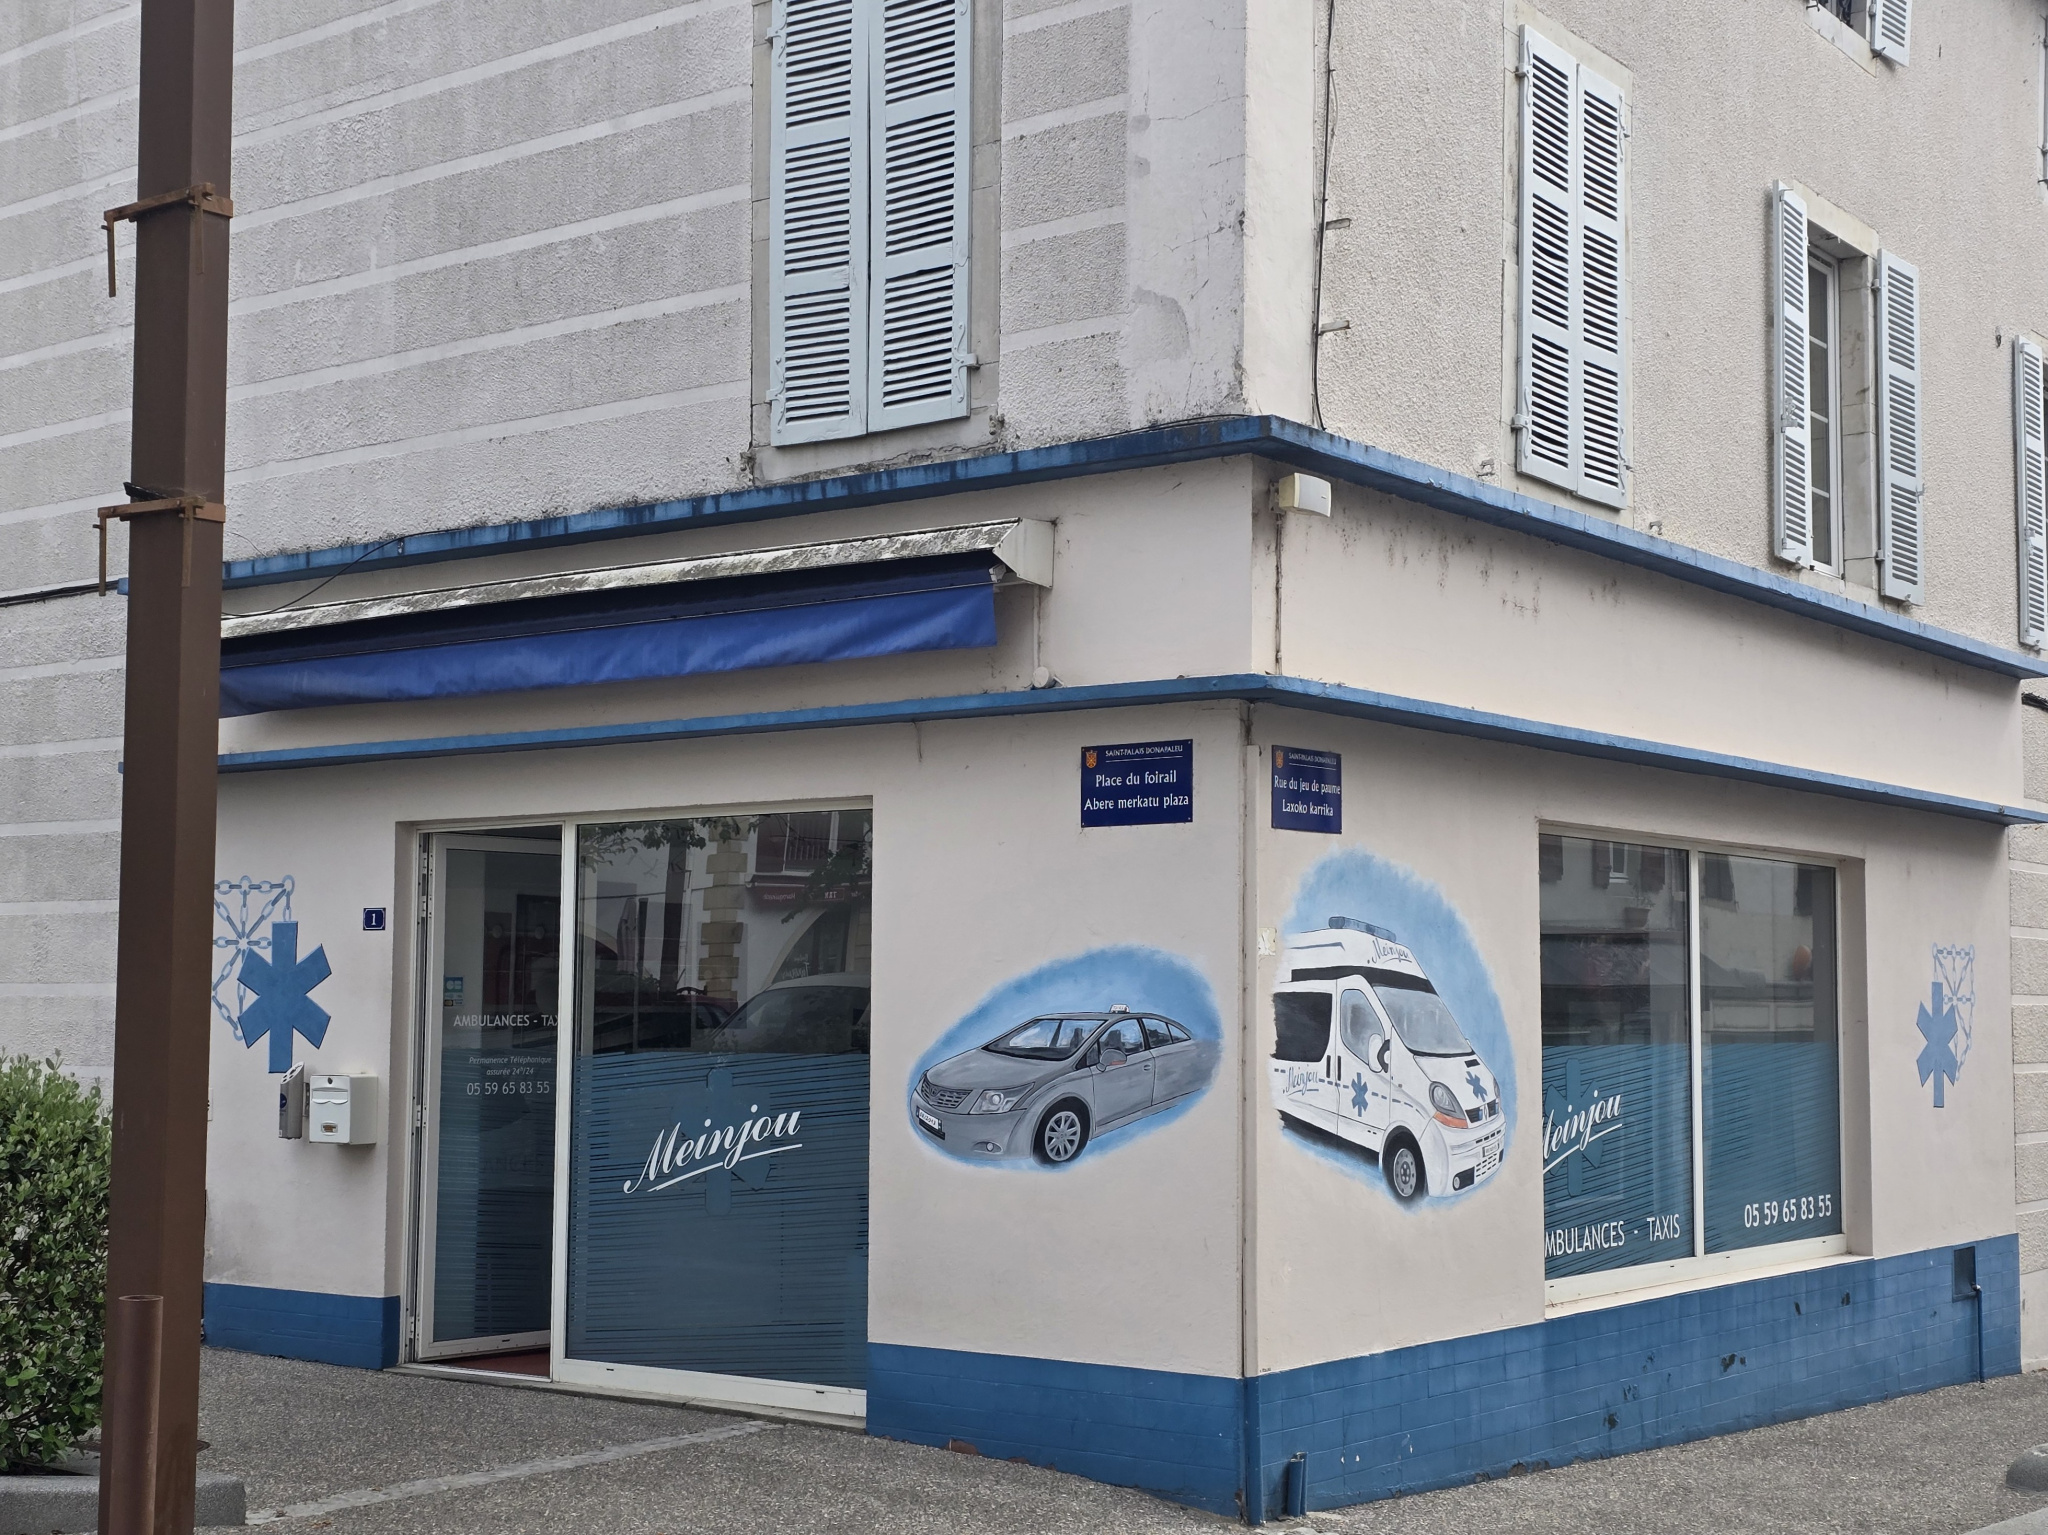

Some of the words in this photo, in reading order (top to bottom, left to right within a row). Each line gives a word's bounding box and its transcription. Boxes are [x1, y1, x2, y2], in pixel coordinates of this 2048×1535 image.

[1105, 747, 1145, 757] SAINT-PALAIS
[1095, 774, 1122, 788] Place
[1126, 772, 1140, 785] du
[1144, 769, 1177, 784] foirail
[1274, 775, 1287, 789] Rue
[1288, 776, 1298, 790] du
[1299, 778, 1310, 792] jeu
[1311, 779, 1319, 792] de
[1320, 783, 1341, 795] paume
[1083, 798, 1114, 811] Abere
[1118, 795, 1159, 808] merkatu
[1163, 793, 1189, 808] plaza
[1282, 799, 1308, 814] Laxoko
[1309, 801, 1334, 817] karrika
[371, 913, 377, 926] 1
[453, 1014, 530, 1027] AMBULANCES
[468, 1056, 508, 1065] Permanence
[486, 1067, 511, 1076] assurée
[466, 1082, 481, 1096] 05
[484, 1082, 499, 1096] 59
[502, 1081, 516, 1095] 65
[519, 1081, 533, 1094] 83
[536, 1081, 550, 1094] 55
[623, 1104, 801, 1194] Meinjou
[1744, 1203, 1760, 1228] 05
[1764, 1201, 1779, 1226] 59
[1782, 1199, 1797, 1223] 65
[1800, 1196, 1815, 1220] 83
[1818, 1194, 1832, 1218] 55
[1544, 1221, 1625, 1258] MBULANCES
[1646, 1214, 1681, 1242] TAXIS
